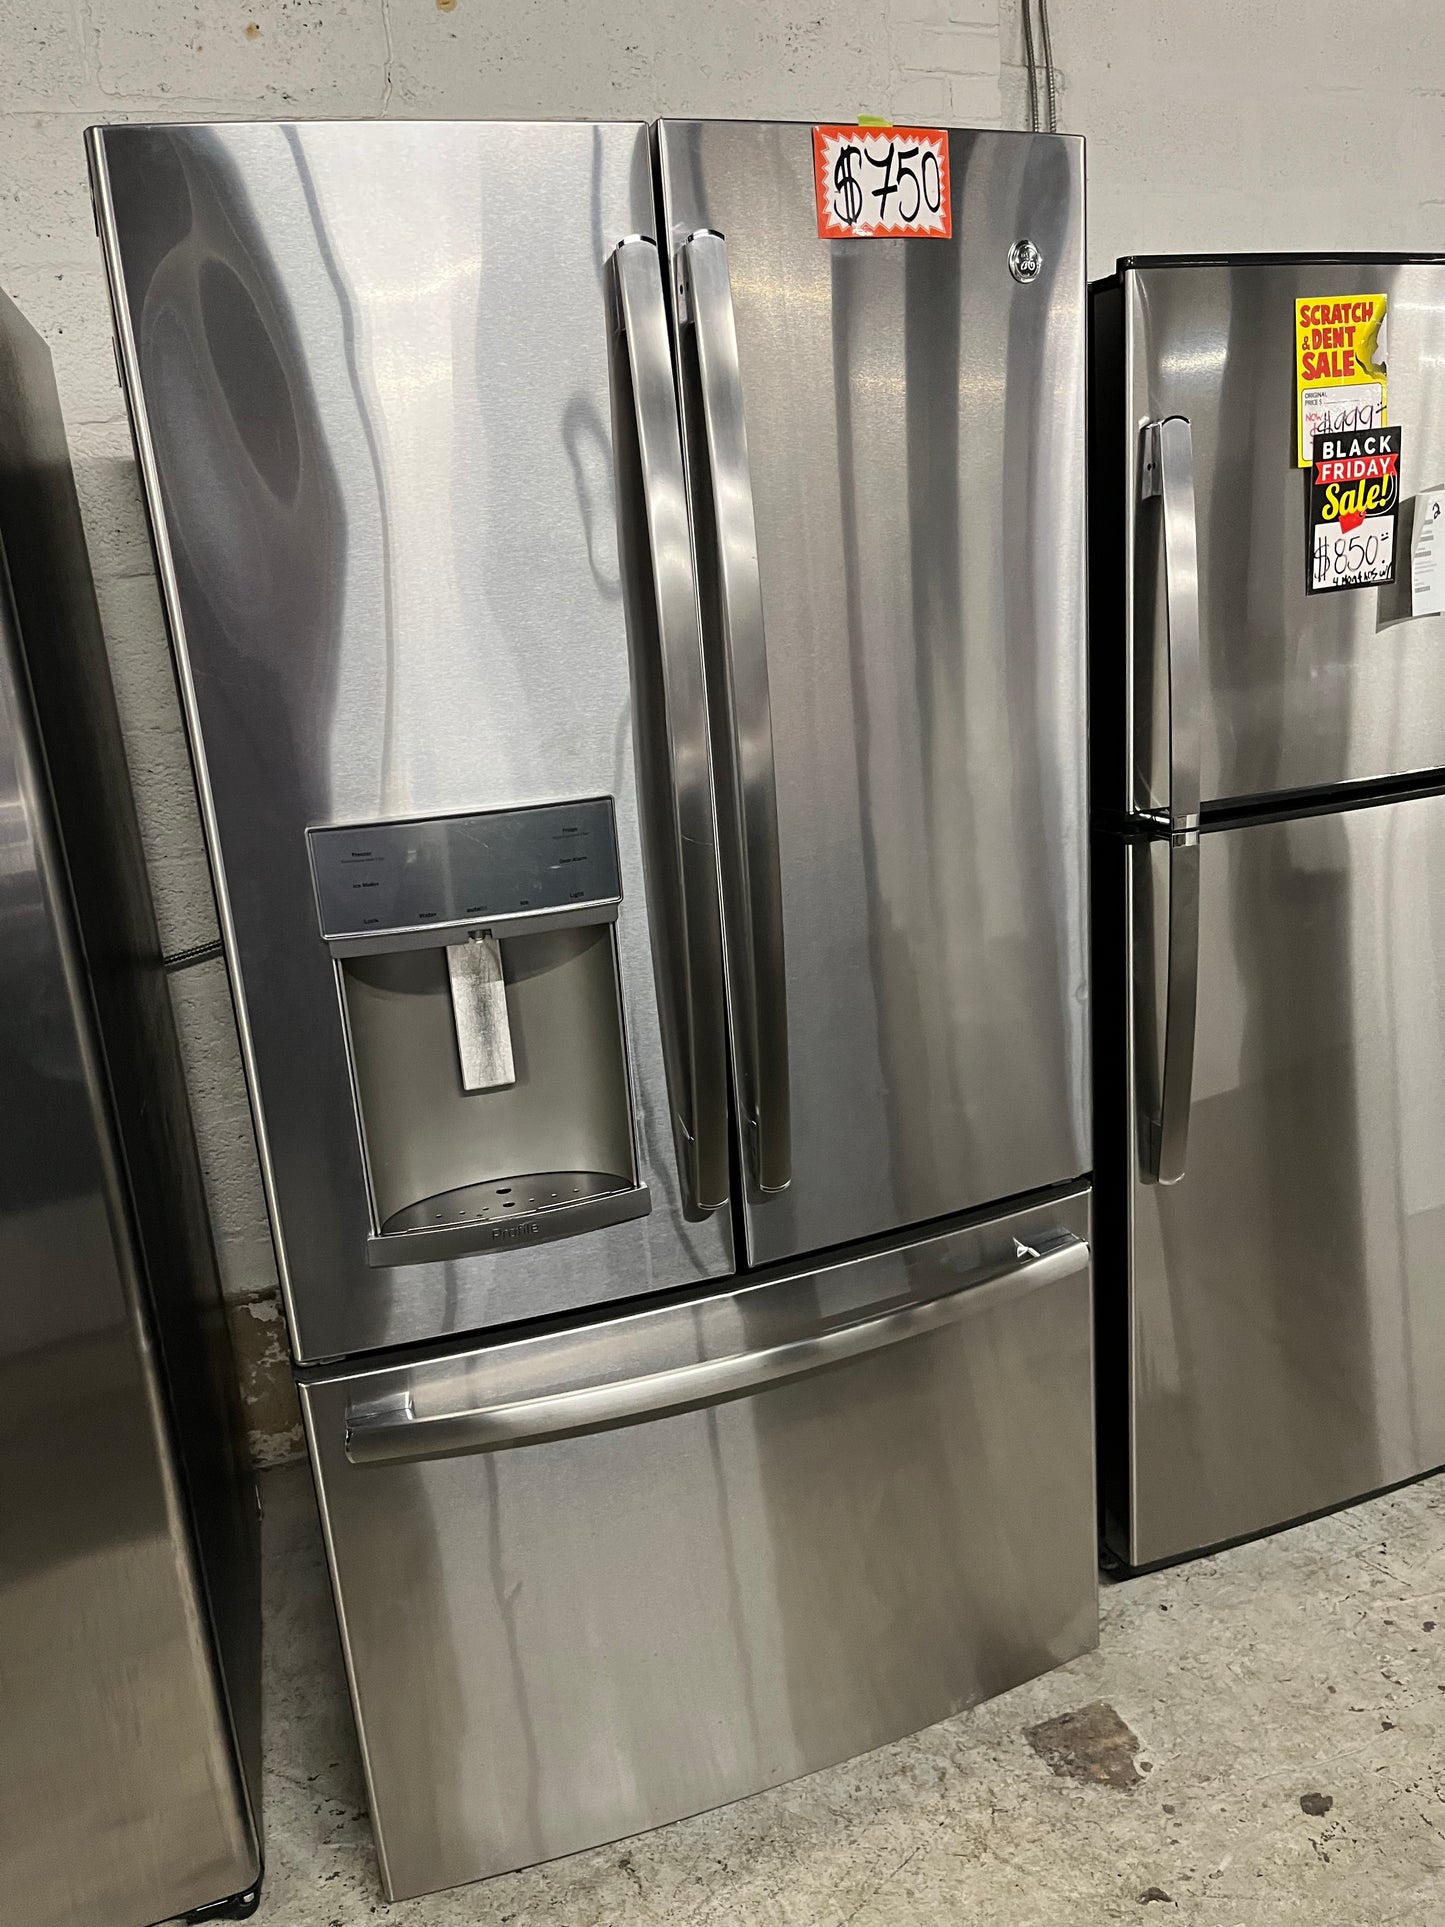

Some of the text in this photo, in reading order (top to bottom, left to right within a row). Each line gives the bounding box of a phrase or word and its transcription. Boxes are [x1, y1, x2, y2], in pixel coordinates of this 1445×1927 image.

[833, 142, 941, 226] $750
[1300, 302, 1374, 328] SCRATCH
[1302, 326, 1356, 351] & DENT
[1302, 350, 1355, 381] SALE
[1305, 412, 1322, 422] NOW
[1322, 435, 1392, 460] BLACK
[1321, 457, 1391, 482] FRIDAY
[1321, 473, 1390, 521] Sale!
[492, 1220, 539, 1239] Profile
